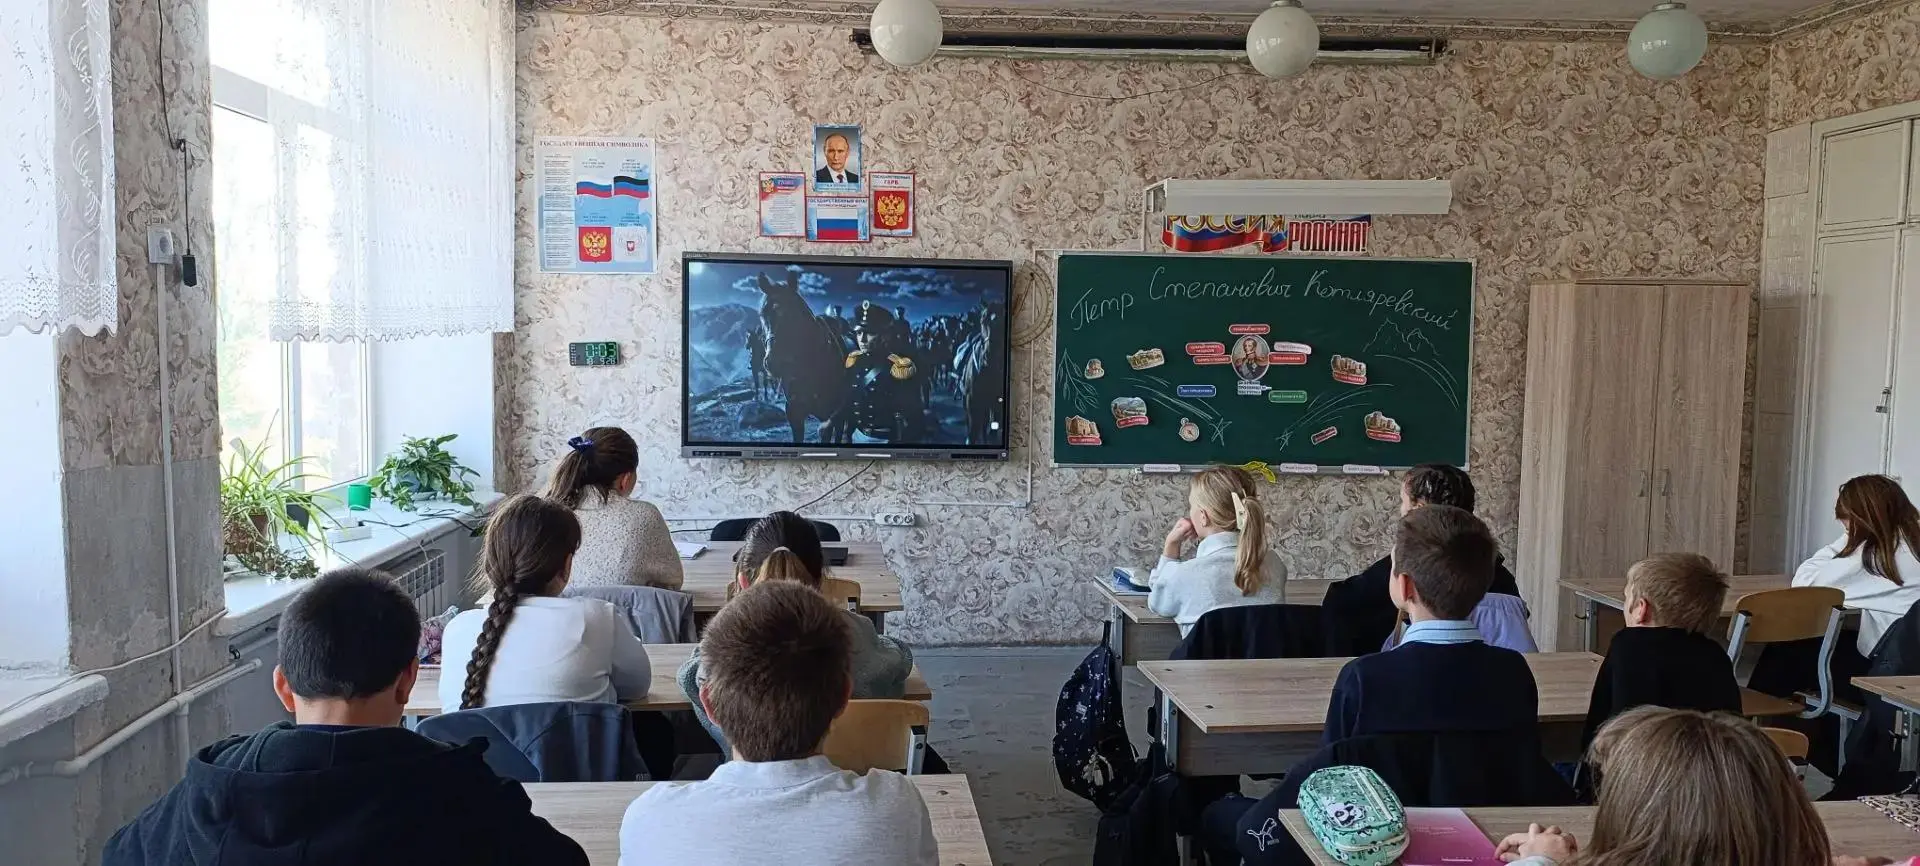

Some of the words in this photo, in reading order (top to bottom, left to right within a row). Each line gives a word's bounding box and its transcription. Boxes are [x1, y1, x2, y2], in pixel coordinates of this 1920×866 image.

[1287, 220, 1369, 252] РОДИНА!
[1070, 287, 1134, 331] Петр
[1149, 266, 1292, 300] Степанович
[1303, 269, 1459, 330] Котляревский
